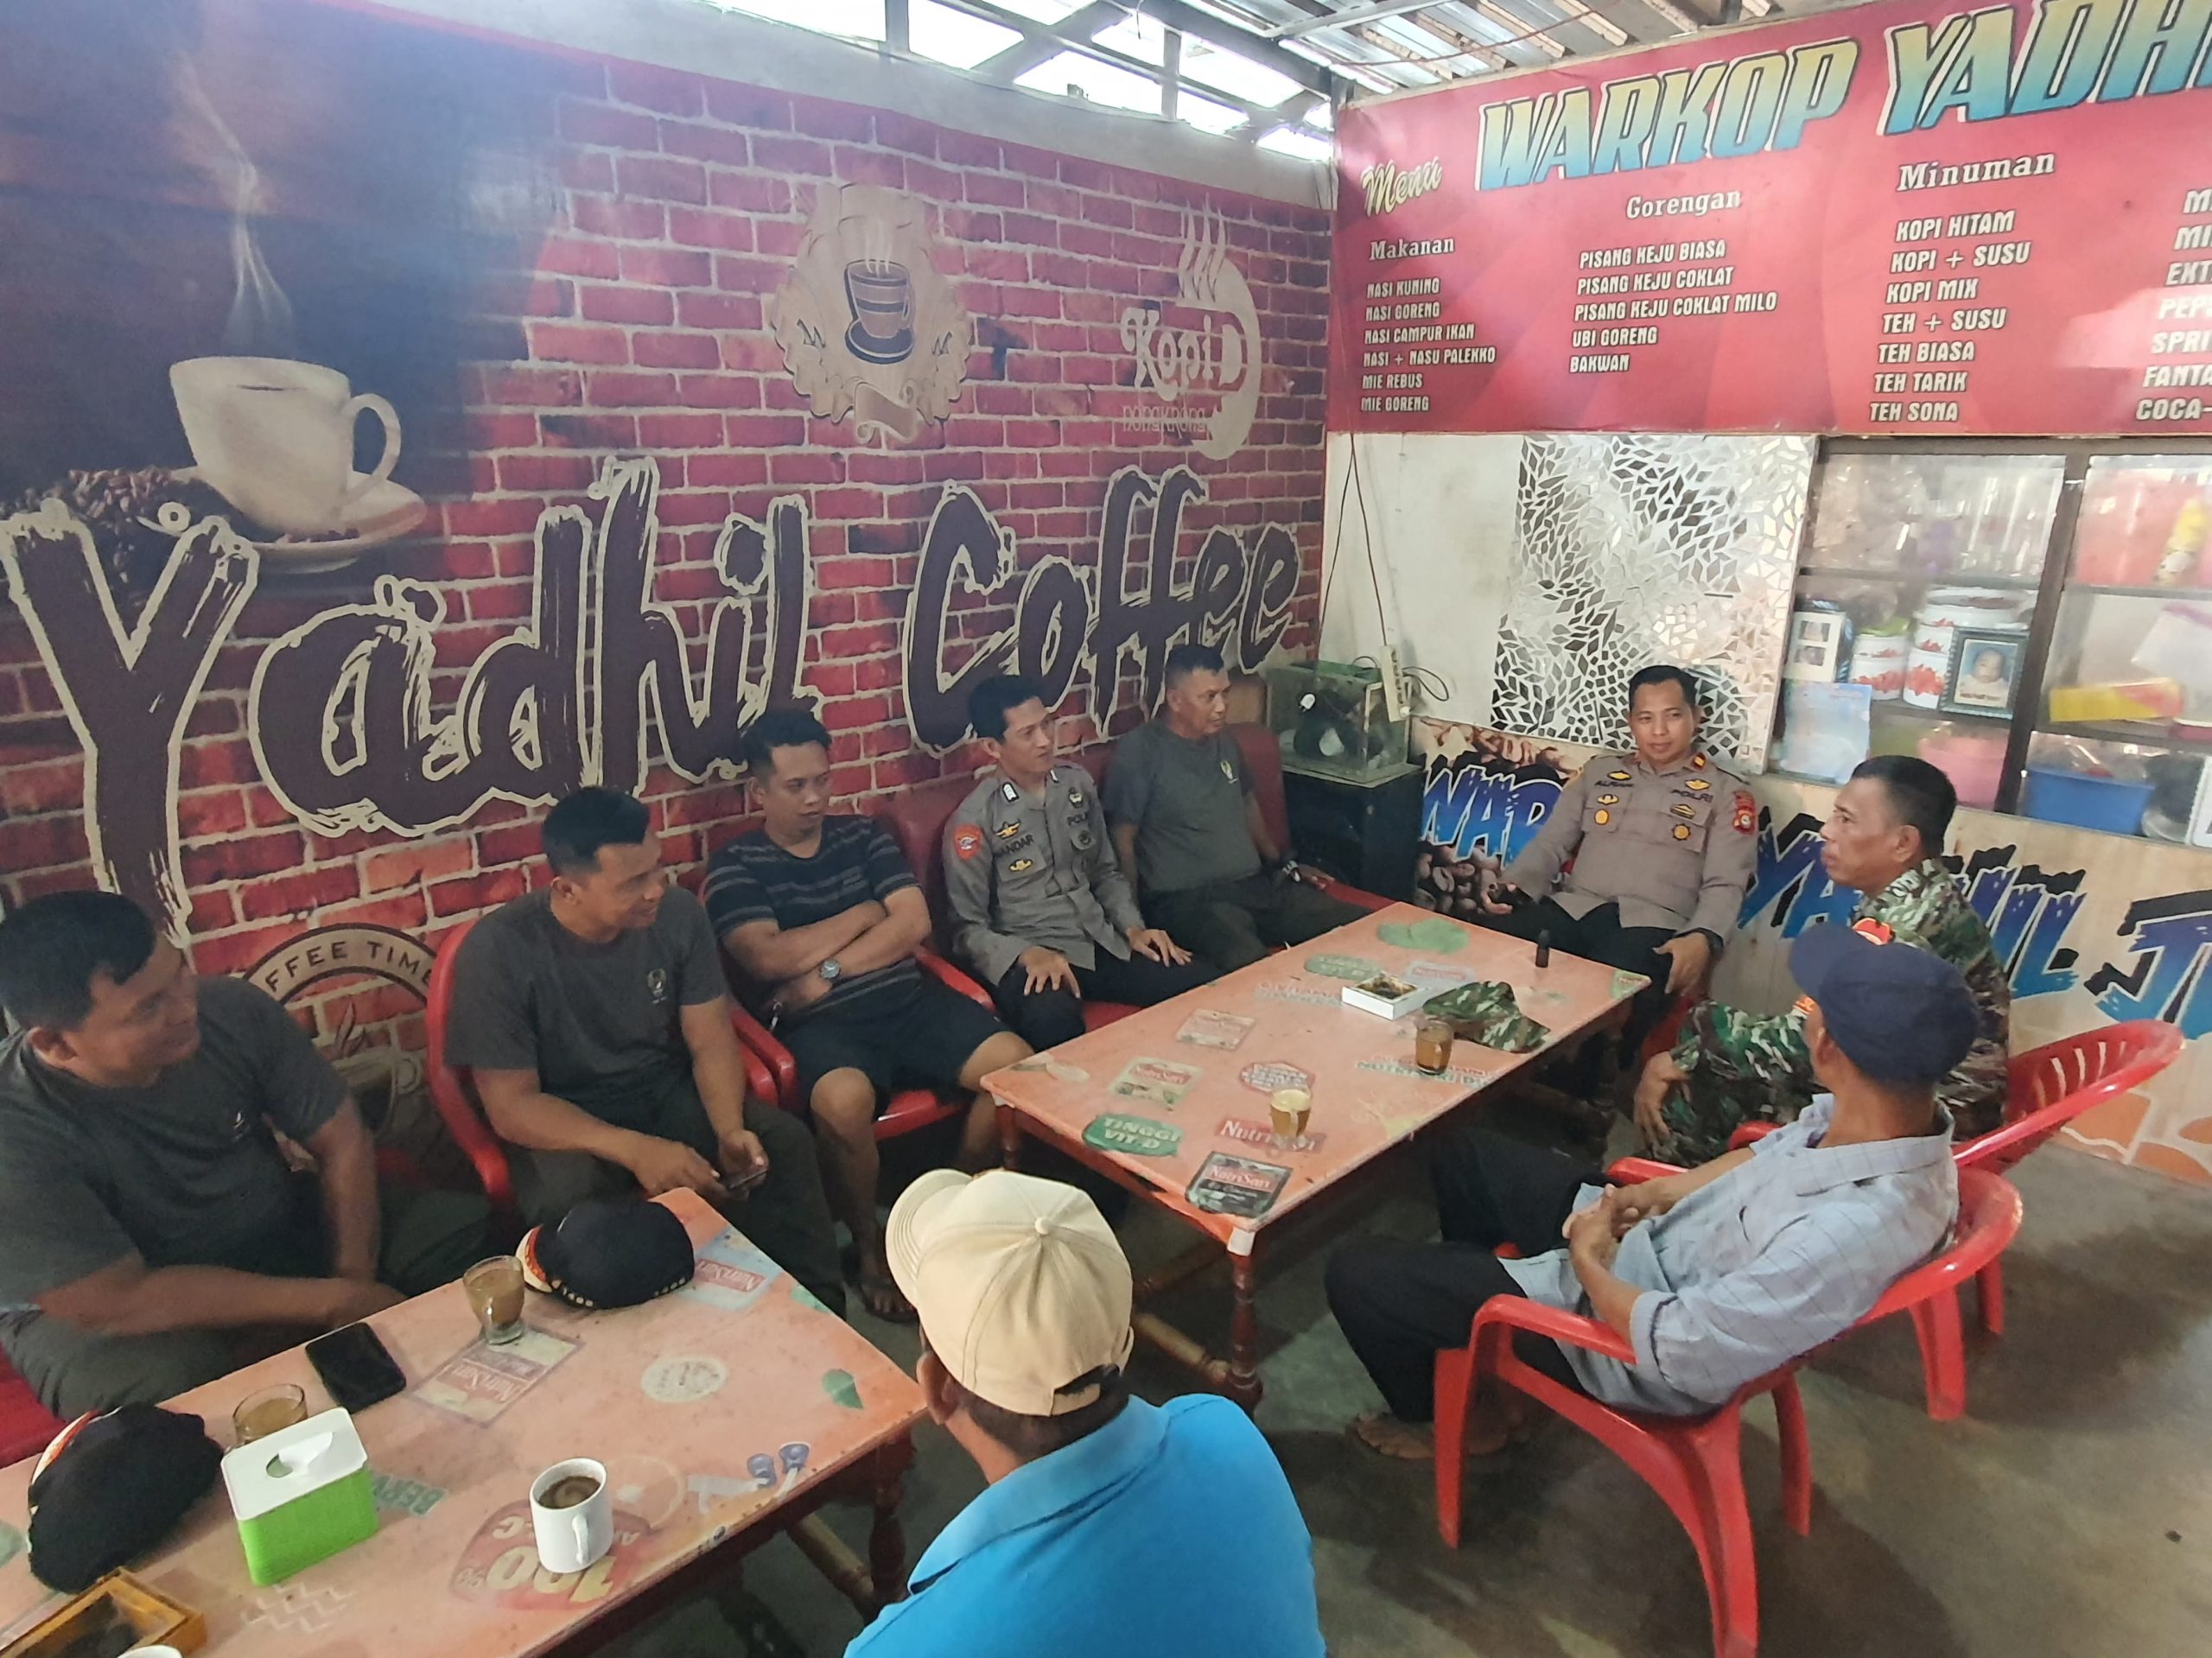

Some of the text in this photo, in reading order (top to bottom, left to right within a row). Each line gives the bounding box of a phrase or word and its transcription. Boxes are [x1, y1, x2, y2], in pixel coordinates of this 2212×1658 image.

[1476, 37, 1859, 191] WARKOP
[1897, 152, 2055, 192] Minuman
[1361, 156, 1442, 217] Menu
[1626, 190, 1741, 219] Gorengan
[1895, 210, 2016, 243] KOPI HITAM
[1370, 238, 1455, 260] Makanan
[1580, 239, 1726, 270] PISANG KEJU BIASA
[1891, 240, 2031, 274] KOPI + SUSU
[1367, 277, 1440, 298] NASI KUNING
[1577, 266, 1734, 295] PISANG KEJU COKLAT
[1885, 277, 1979, 303] KOPI MIX
[1366, 302, 1440, 321] NASI GORENG
[1574, 291, 1777, 321] PISANG KEJU COKLAT MILO
[1364, 323, 1475, 344] NASI CAMPUR IKAN
[1882, 308, 2007, 334] TEH + SUSU
[1573, 327, 1657, 347] UBI GORENG
[1363, 352, 1389, 367] NASI
[1409, 350, 1440, 365] NASU
[1443, 347, 1496, 364] PALEKKO
[1570, 354, 1630, 372] BAKWAN
[1878, 341, 1974, 364] TEH BIASA
[1363, 373, 1423, 389] MIE REBUS
[1874, 372, 1968, 392] TEH TARIK
[1361, 397, 1429, 411] MIE GORENG
[1870, 403, 1902, 422] TEH
[0, 456, 1300, 949] Yadhil Coffee
[264, 941, 346, 993] FFEE
[1105, 1117, 1179, 1141] TINGGI
